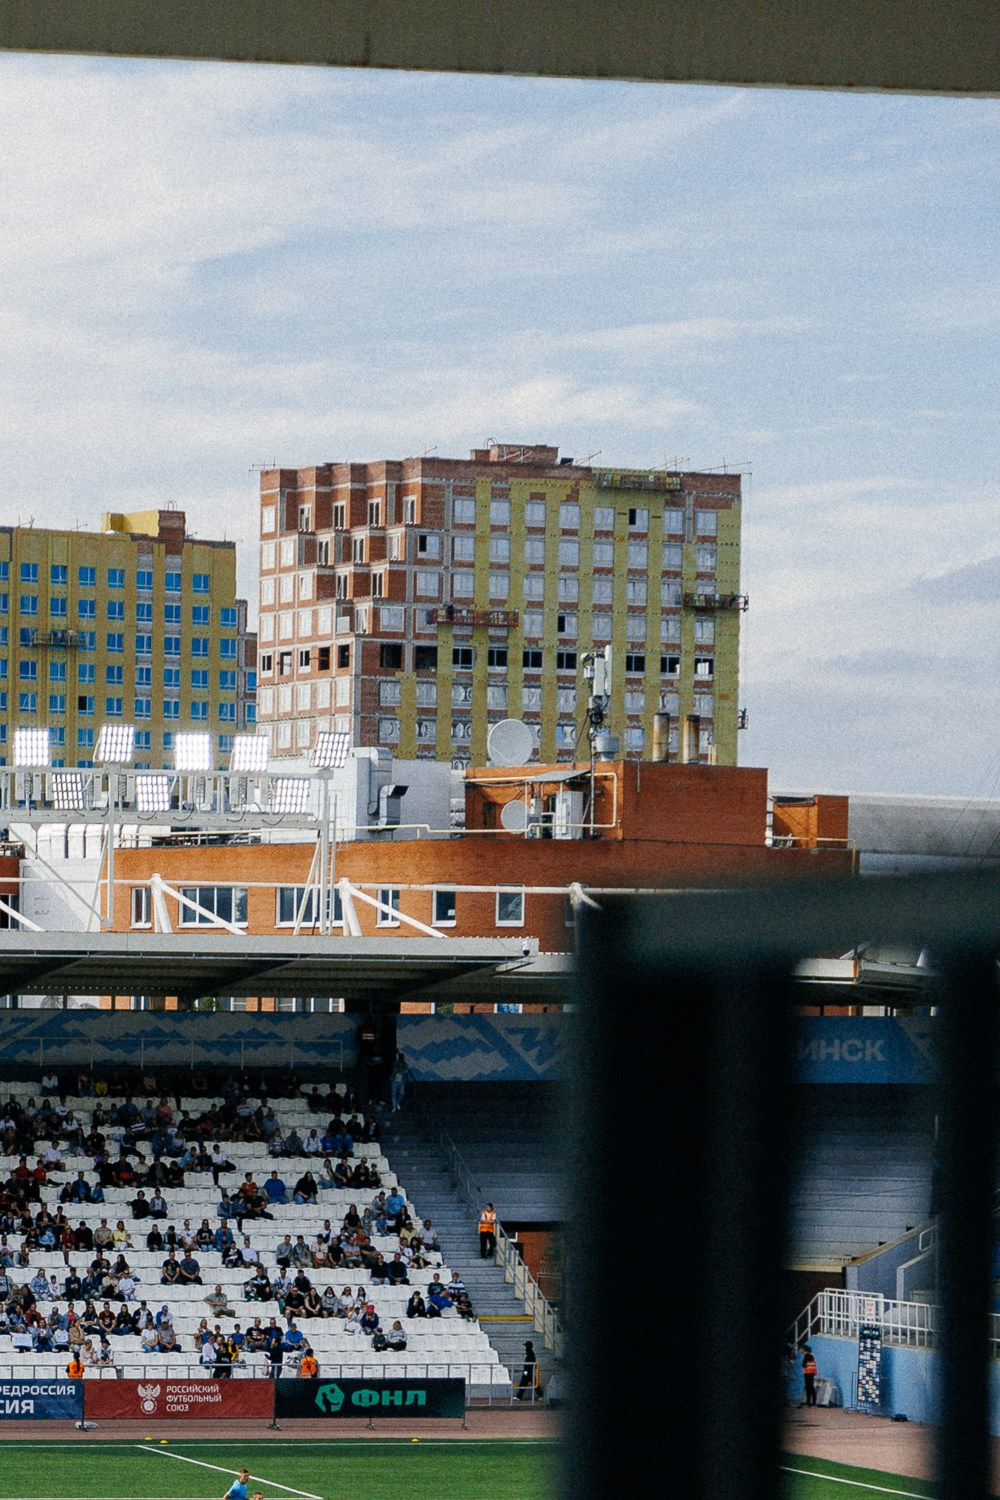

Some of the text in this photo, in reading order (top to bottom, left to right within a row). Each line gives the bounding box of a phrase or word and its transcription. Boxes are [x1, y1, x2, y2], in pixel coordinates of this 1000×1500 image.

[166, 1384, 220, 1393] РОССИЙСКИЙ
[166, 1393, 222, 1403] ФУТБОЛЬНЫЙ
[351, 1389, 427, 1407] ФНЛ
[166, 1404, 189, 1412] СОЮЗ
